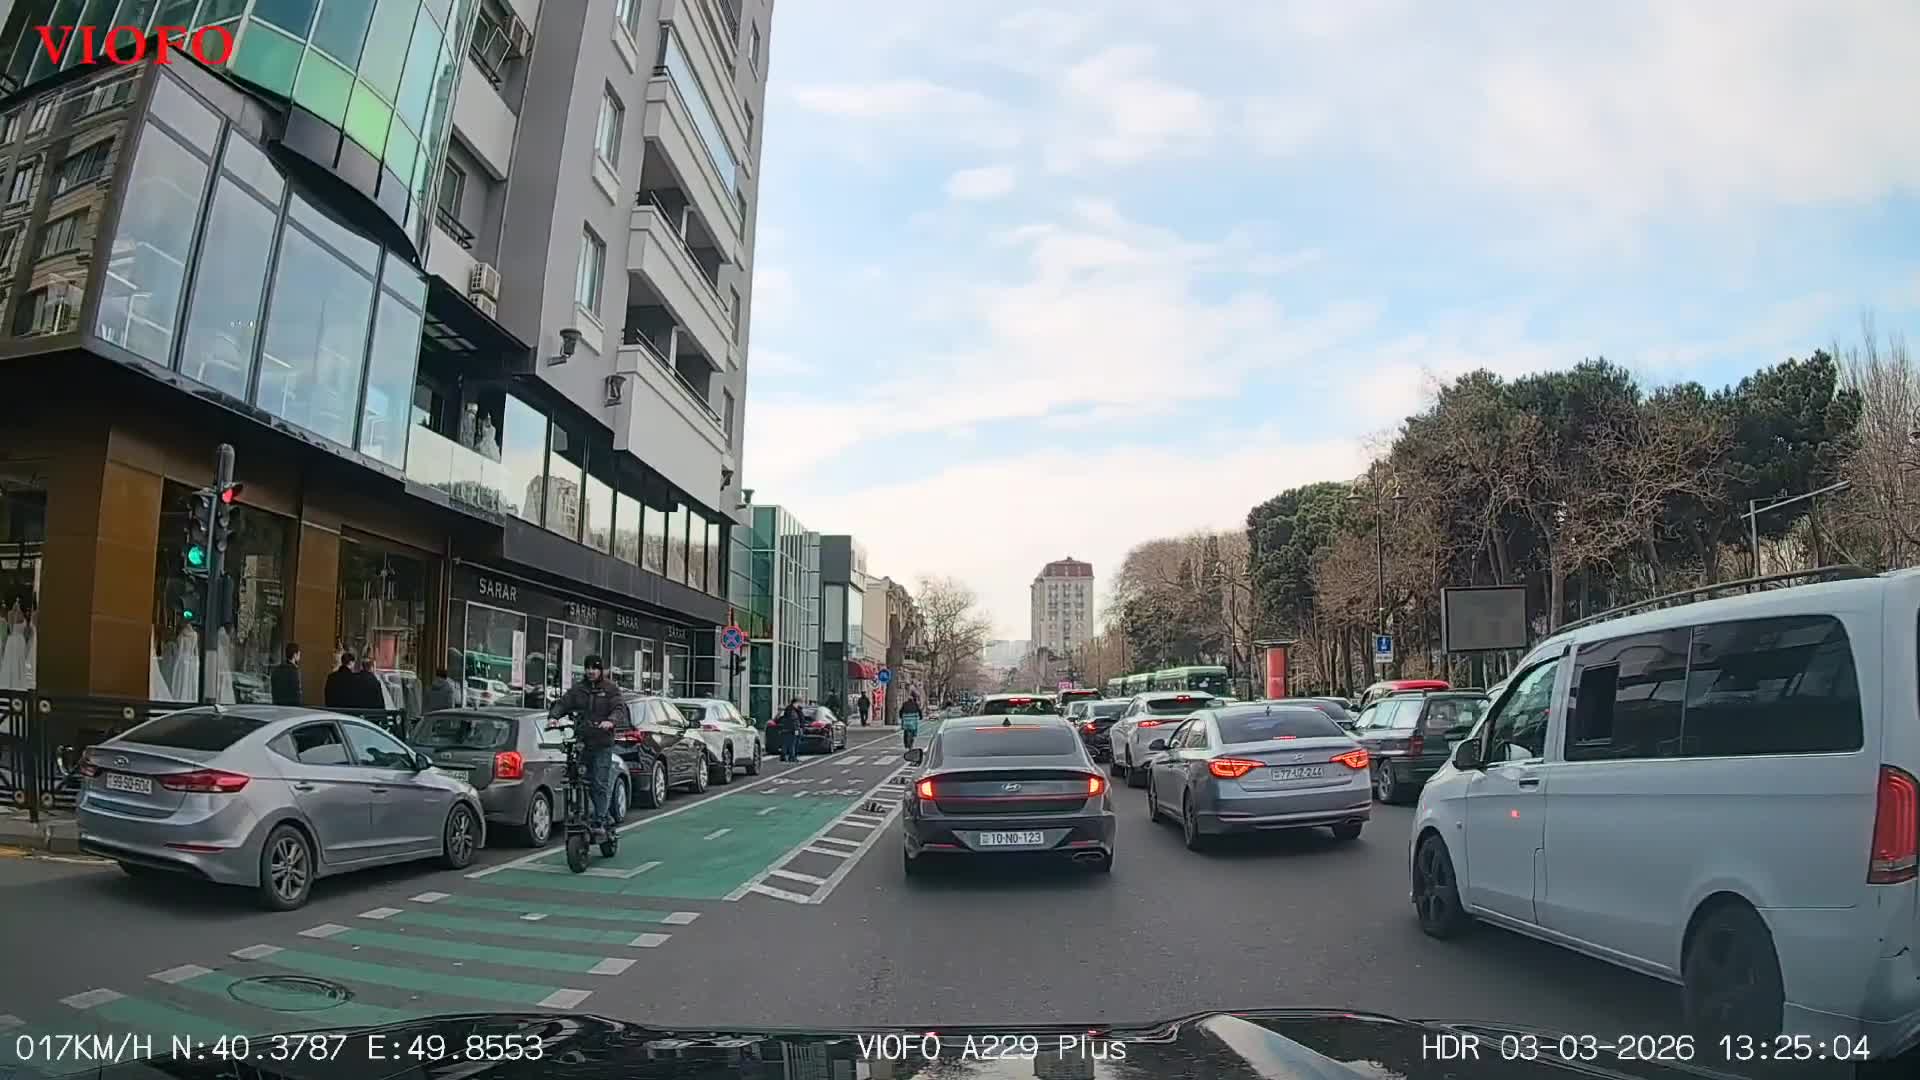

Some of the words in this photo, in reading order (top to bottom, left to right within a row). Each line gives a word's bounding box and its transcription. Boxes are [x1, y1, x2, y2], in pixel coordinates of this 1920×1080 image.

[479, 578, 517, 601] SARAR
[569, 602, 598, 619] SARAR
[616, 614, 640, 630] SARAR
